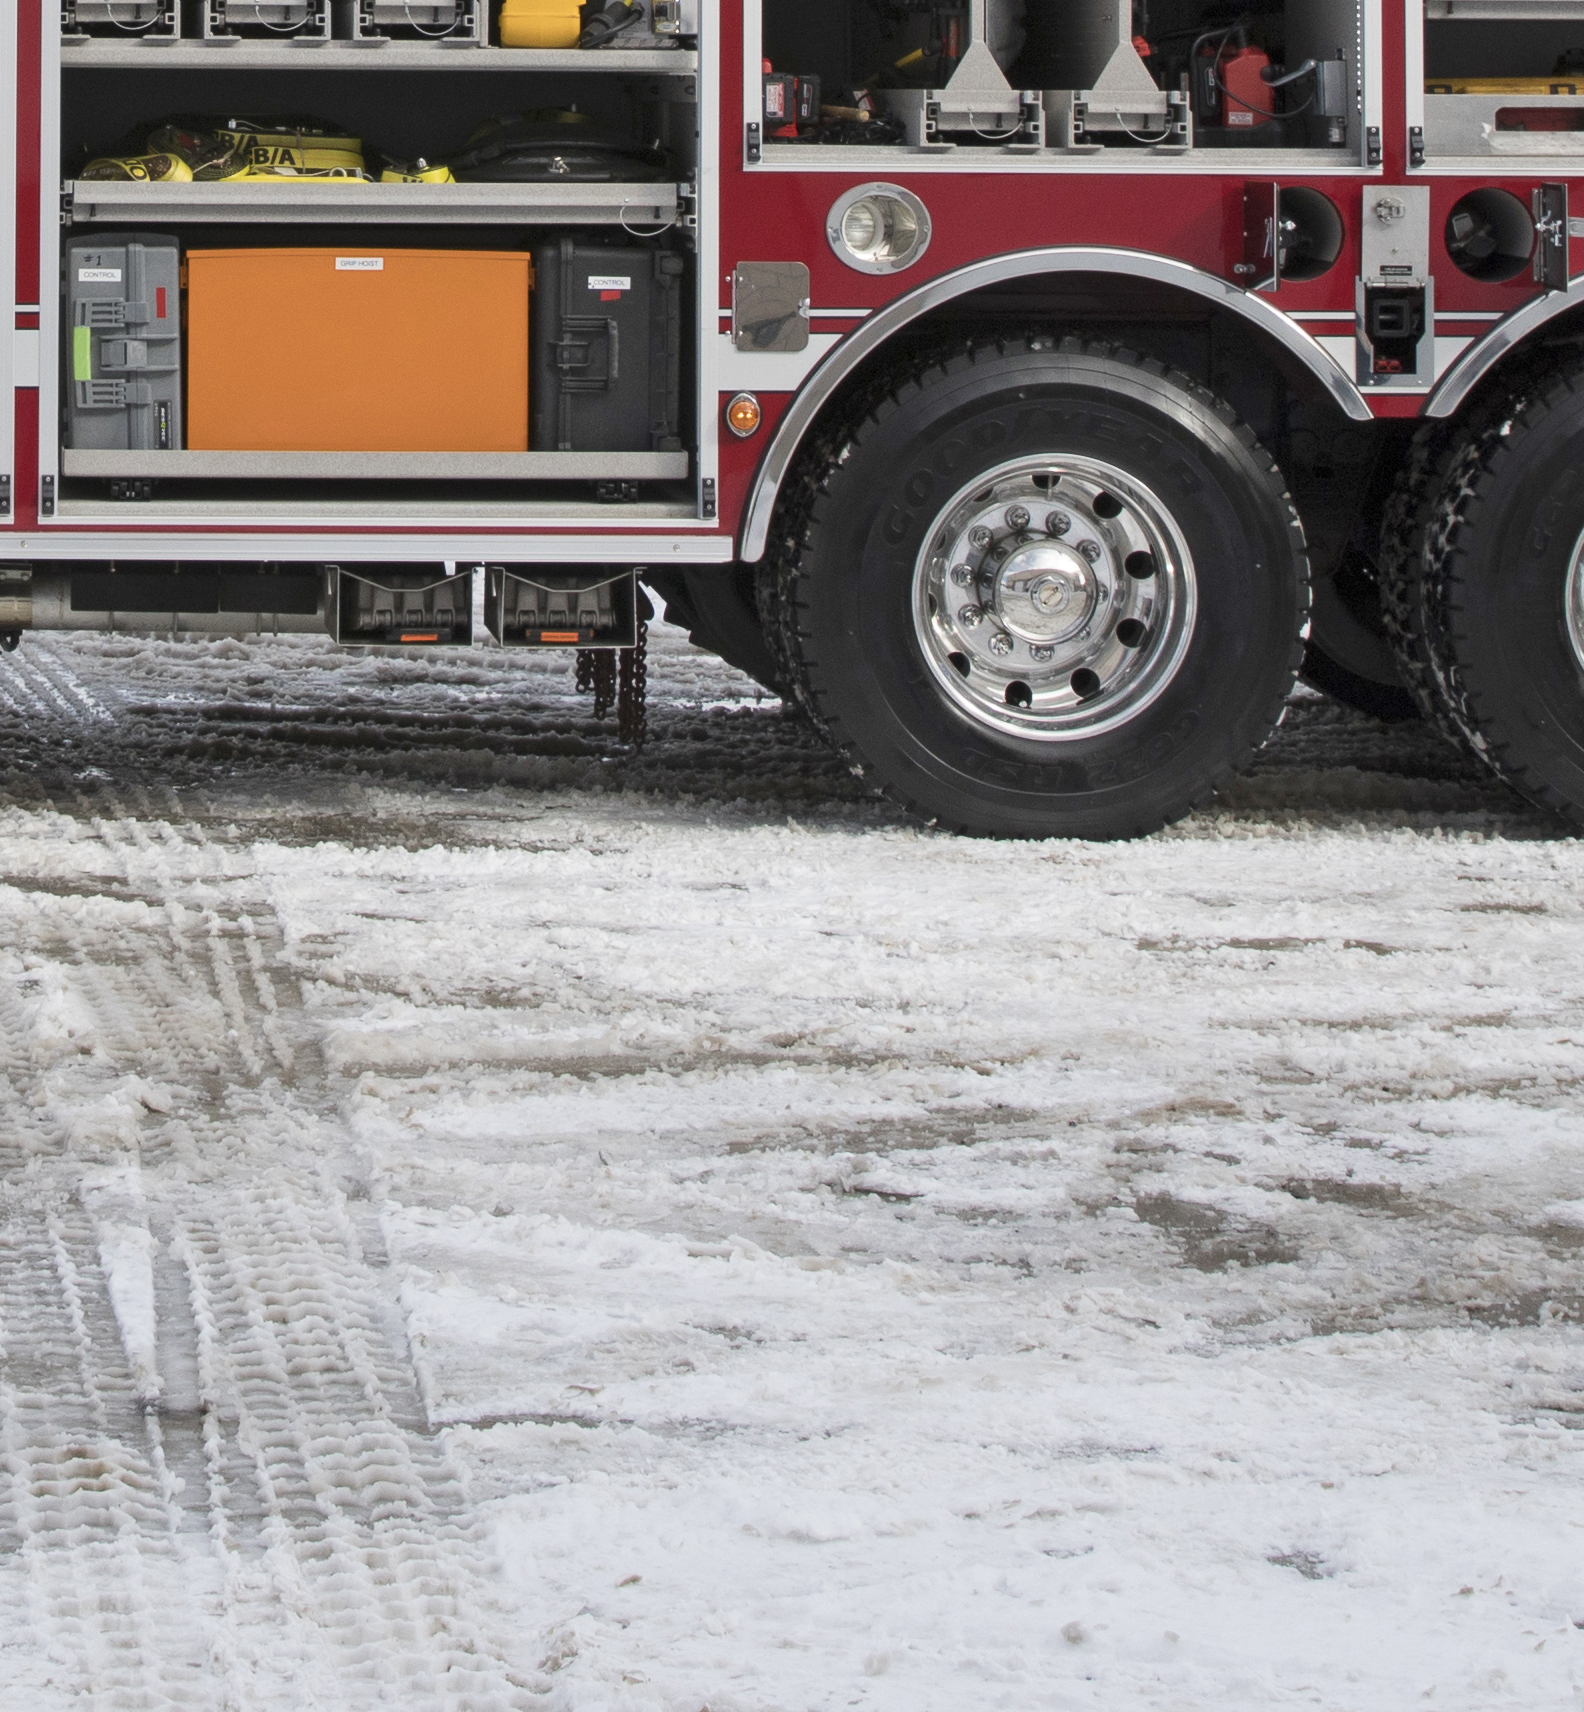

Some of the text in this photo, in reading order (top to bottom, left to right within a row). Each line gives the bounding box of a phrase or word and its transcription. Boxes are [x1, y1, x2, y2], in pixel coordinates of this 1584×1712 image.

[340, 259, 358, 267] GRIP
[84, 271, 117, 279] CONTROL
[593, 279, 626, 287] CONTROL
